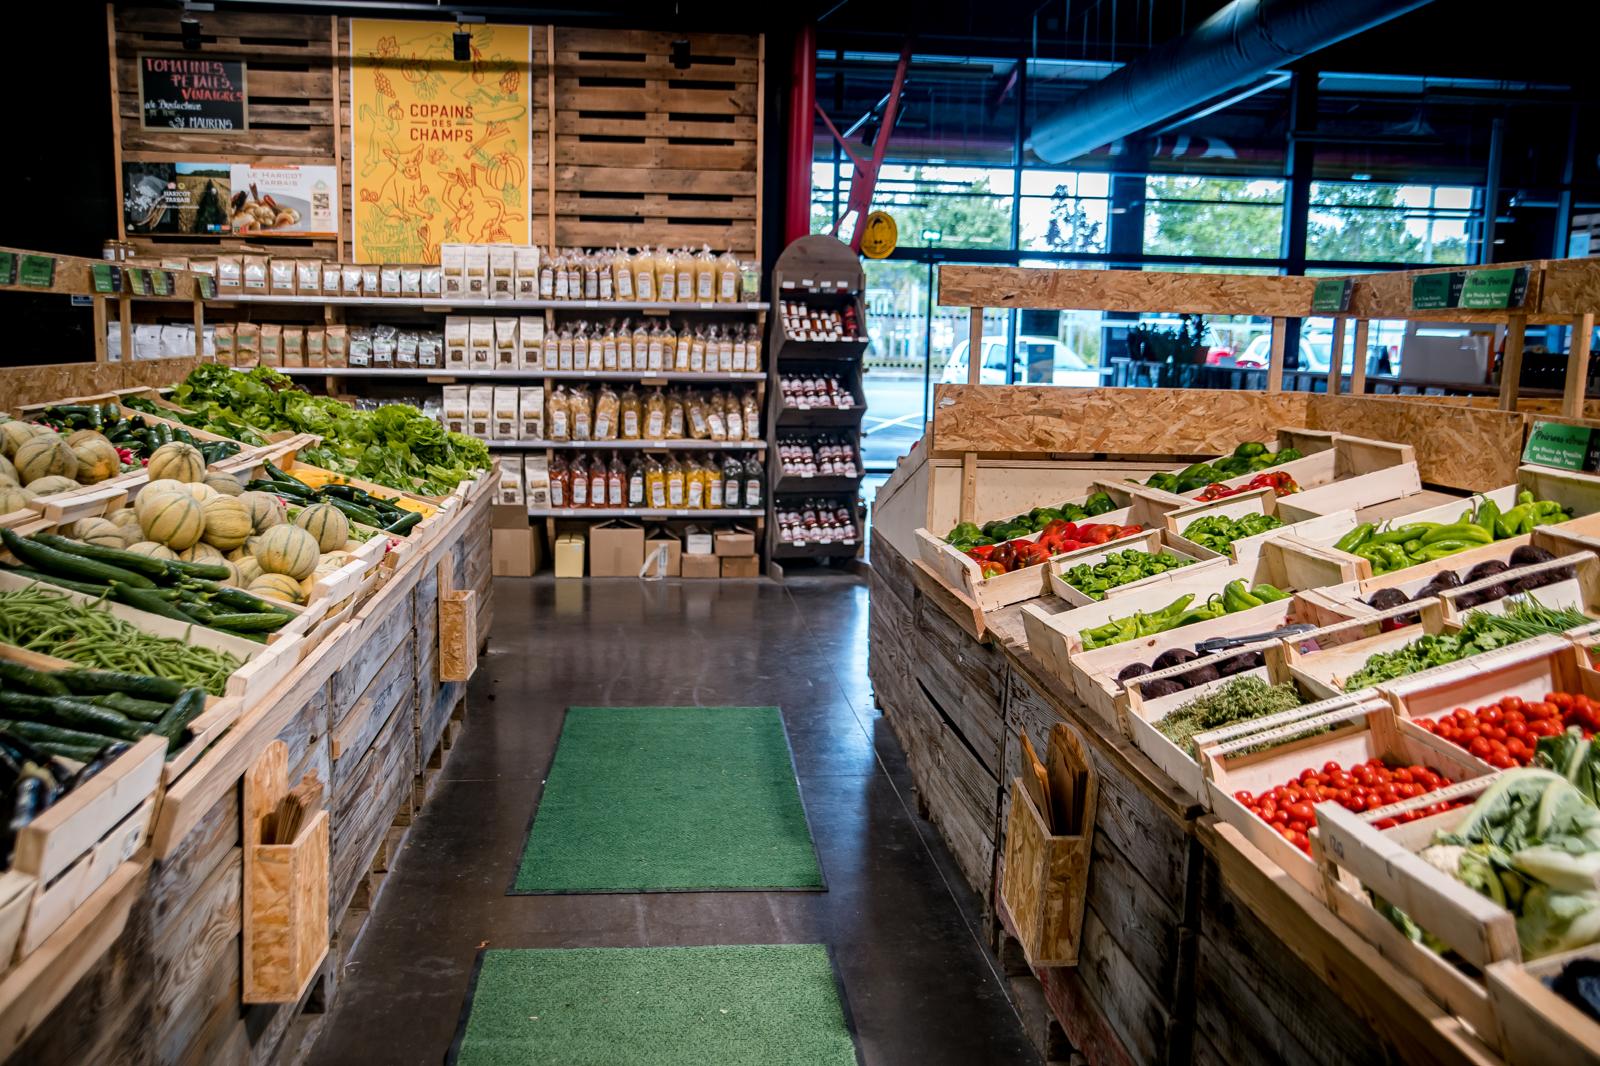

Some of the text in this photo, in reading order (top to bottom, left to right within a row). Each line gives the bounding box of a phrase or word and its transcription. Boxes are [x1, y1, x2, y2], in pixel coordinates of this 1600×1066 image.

[181, 88, 245, 102] VINAIGRES
[410, 104, 473, 119] COPAINS
[190, 116, 233, 130] MAURENS
[431, 119, 452, 128] DES
[410, 127, 473, 143] CHAMPS
